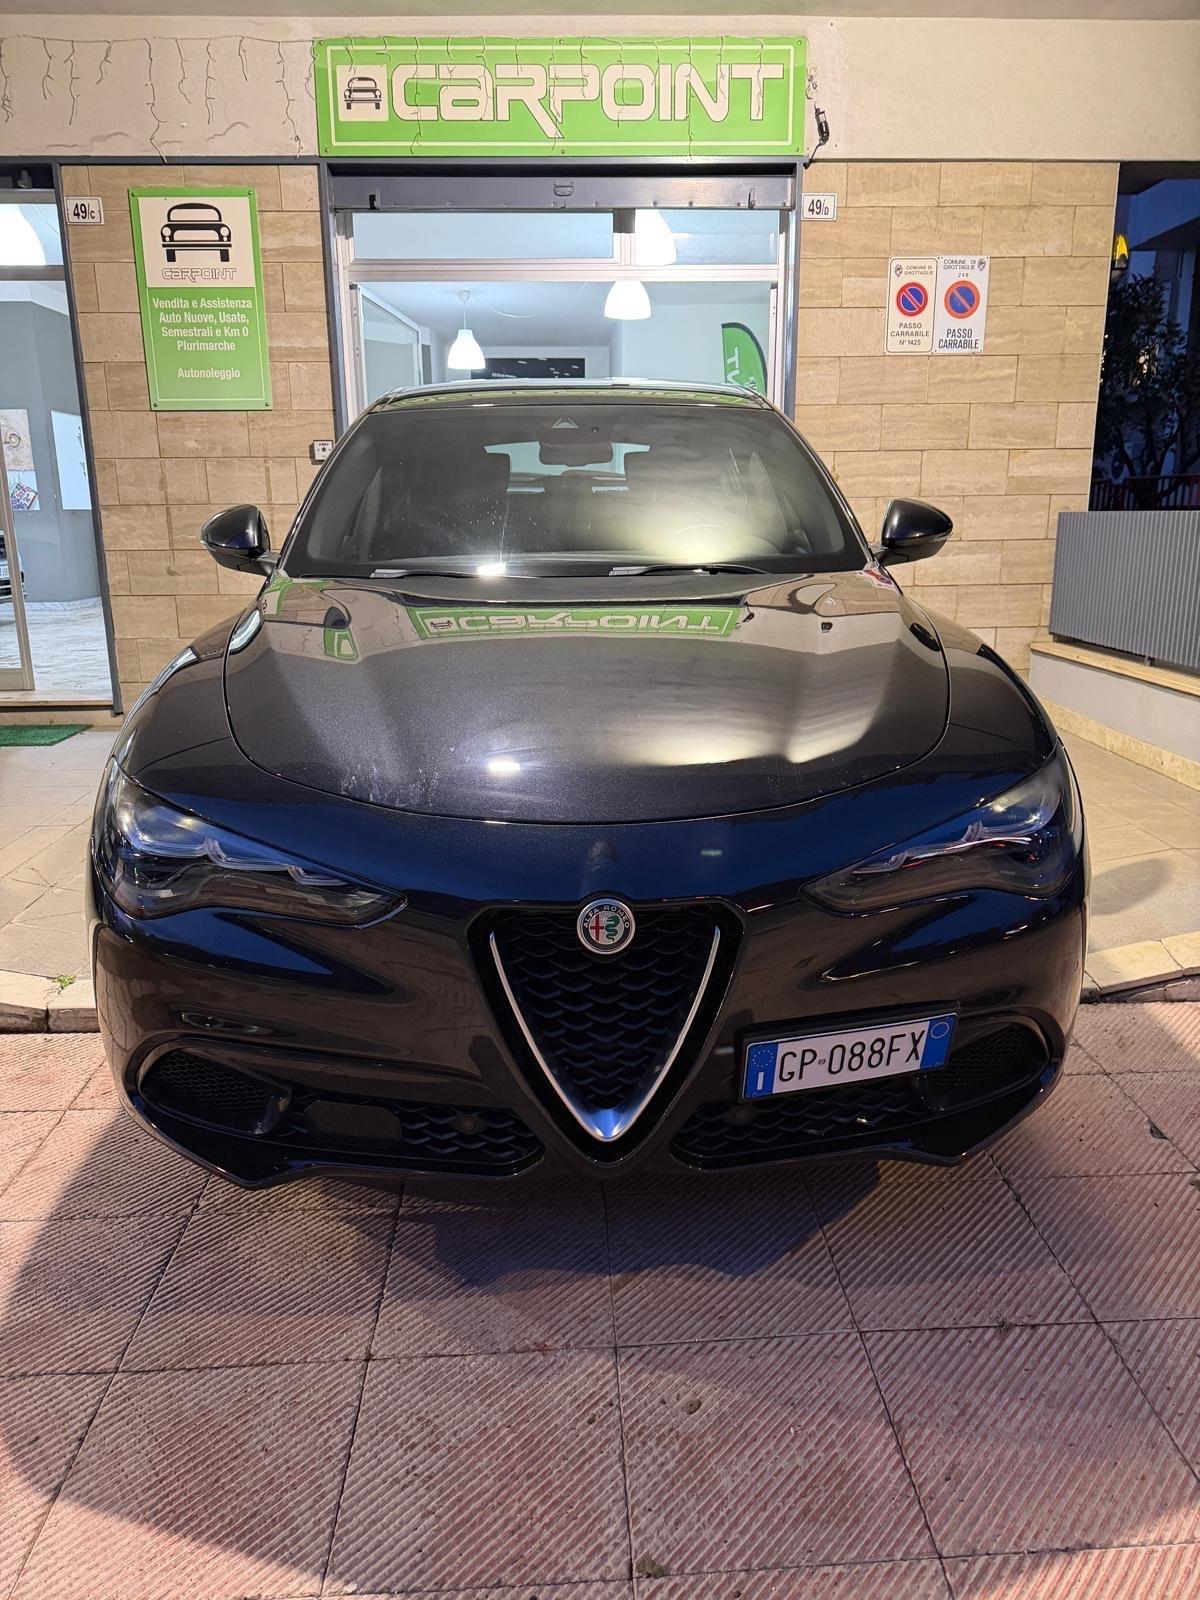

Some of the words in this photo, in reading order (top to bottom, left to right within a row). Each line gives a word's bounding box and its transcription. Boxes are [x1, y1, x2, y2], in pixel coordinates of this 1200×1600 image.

[808, 199, 830, 216] 49/D
[152, 298, 189, 309] Vendita
[191, 300, 198, 309] e
[200, 298, 253, 309] Assistenza
[159, 312, 181, 323] Auto
[184, 312, 217, 325] Nuove,
[219, 312, 249, 325] Usate,
[161, 326, 213, 337] Semestrali
[215, 328, 222, 337] e
[224, 326, 240, 337] Km
[946, 328, 973, 339] PASSO
[177, 340, 236, 351] Plurimarche
[938, 339, 980, 349] CARRABILE
[177, 368, 241, 380] Autonoleggio
[583, 908, 600, 928] ALFA
[603, 905, 630, 928] ROMEO
